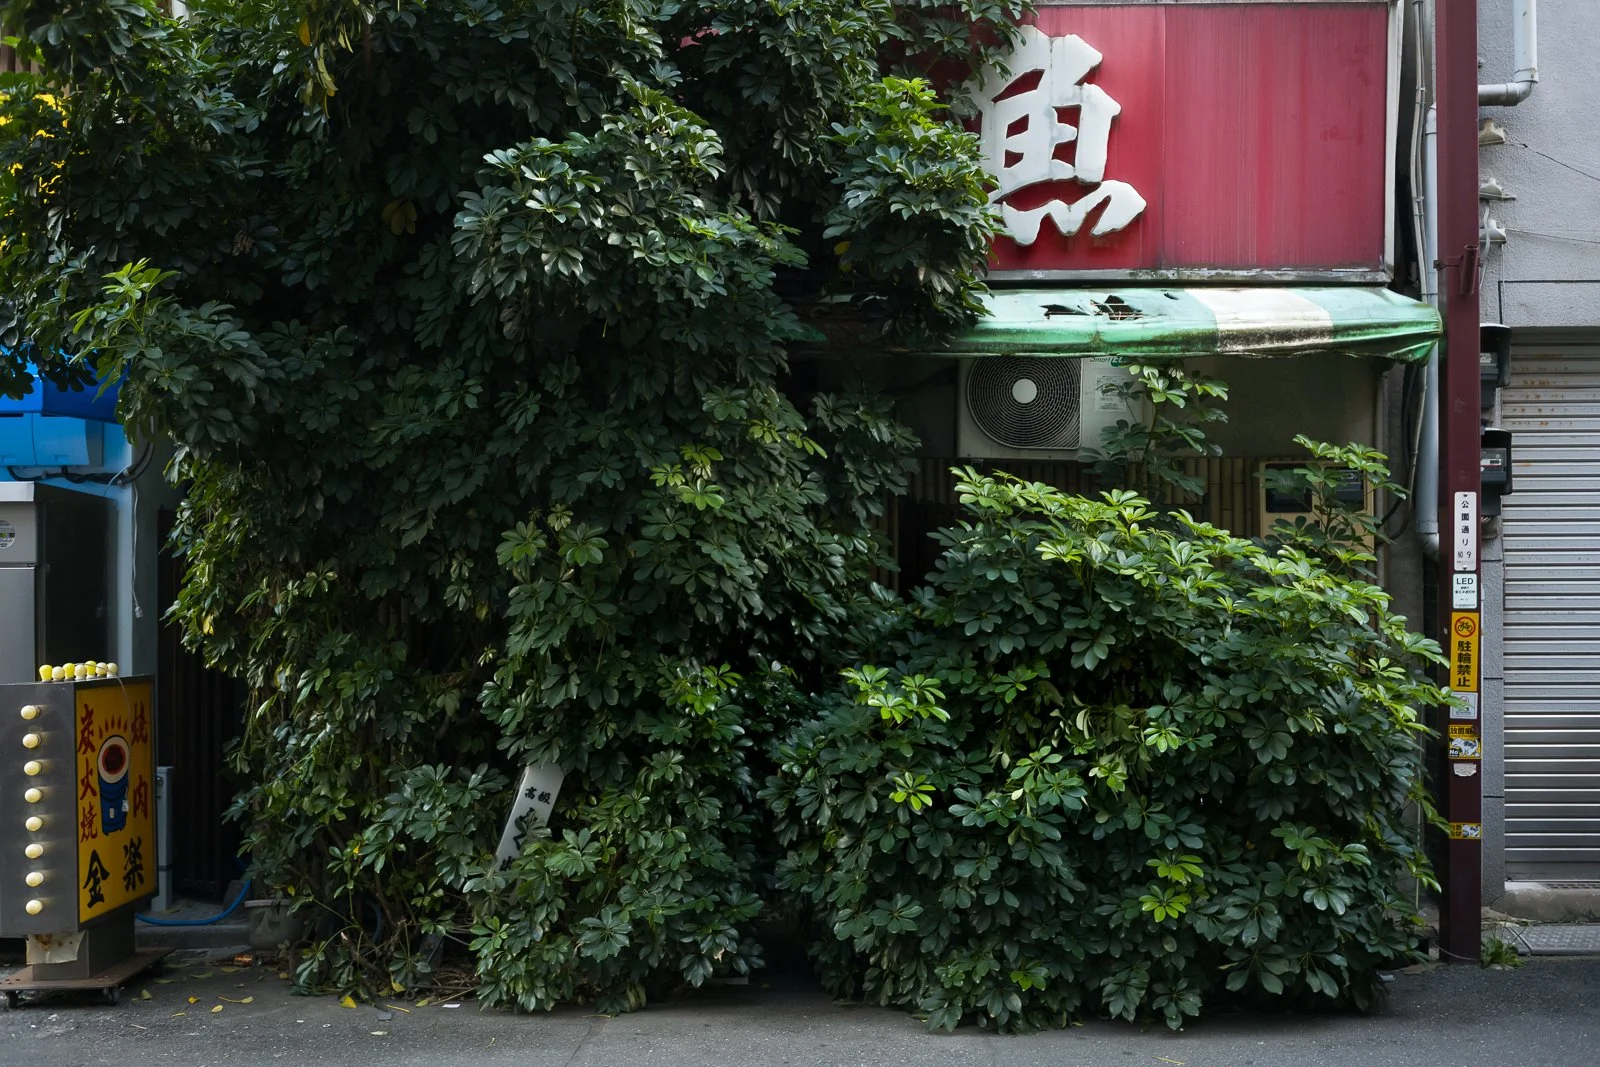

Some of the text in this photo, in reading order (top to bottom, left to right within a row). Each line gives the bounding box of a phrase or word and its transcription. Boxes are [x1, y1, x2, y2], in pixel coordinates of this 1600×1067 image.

[962, 24, 1147, 247] 魚
[1461, 500, 1470, 546] 公園通り
[1456, 577, 1474, 585] LED
[1456, 640, 1472, 688] 駐輪禁止
[77, 703, 98, 844] 炭火焼
[130, 700, 149, 821] 焼肉
[524, 786, 551, 805] 高級
